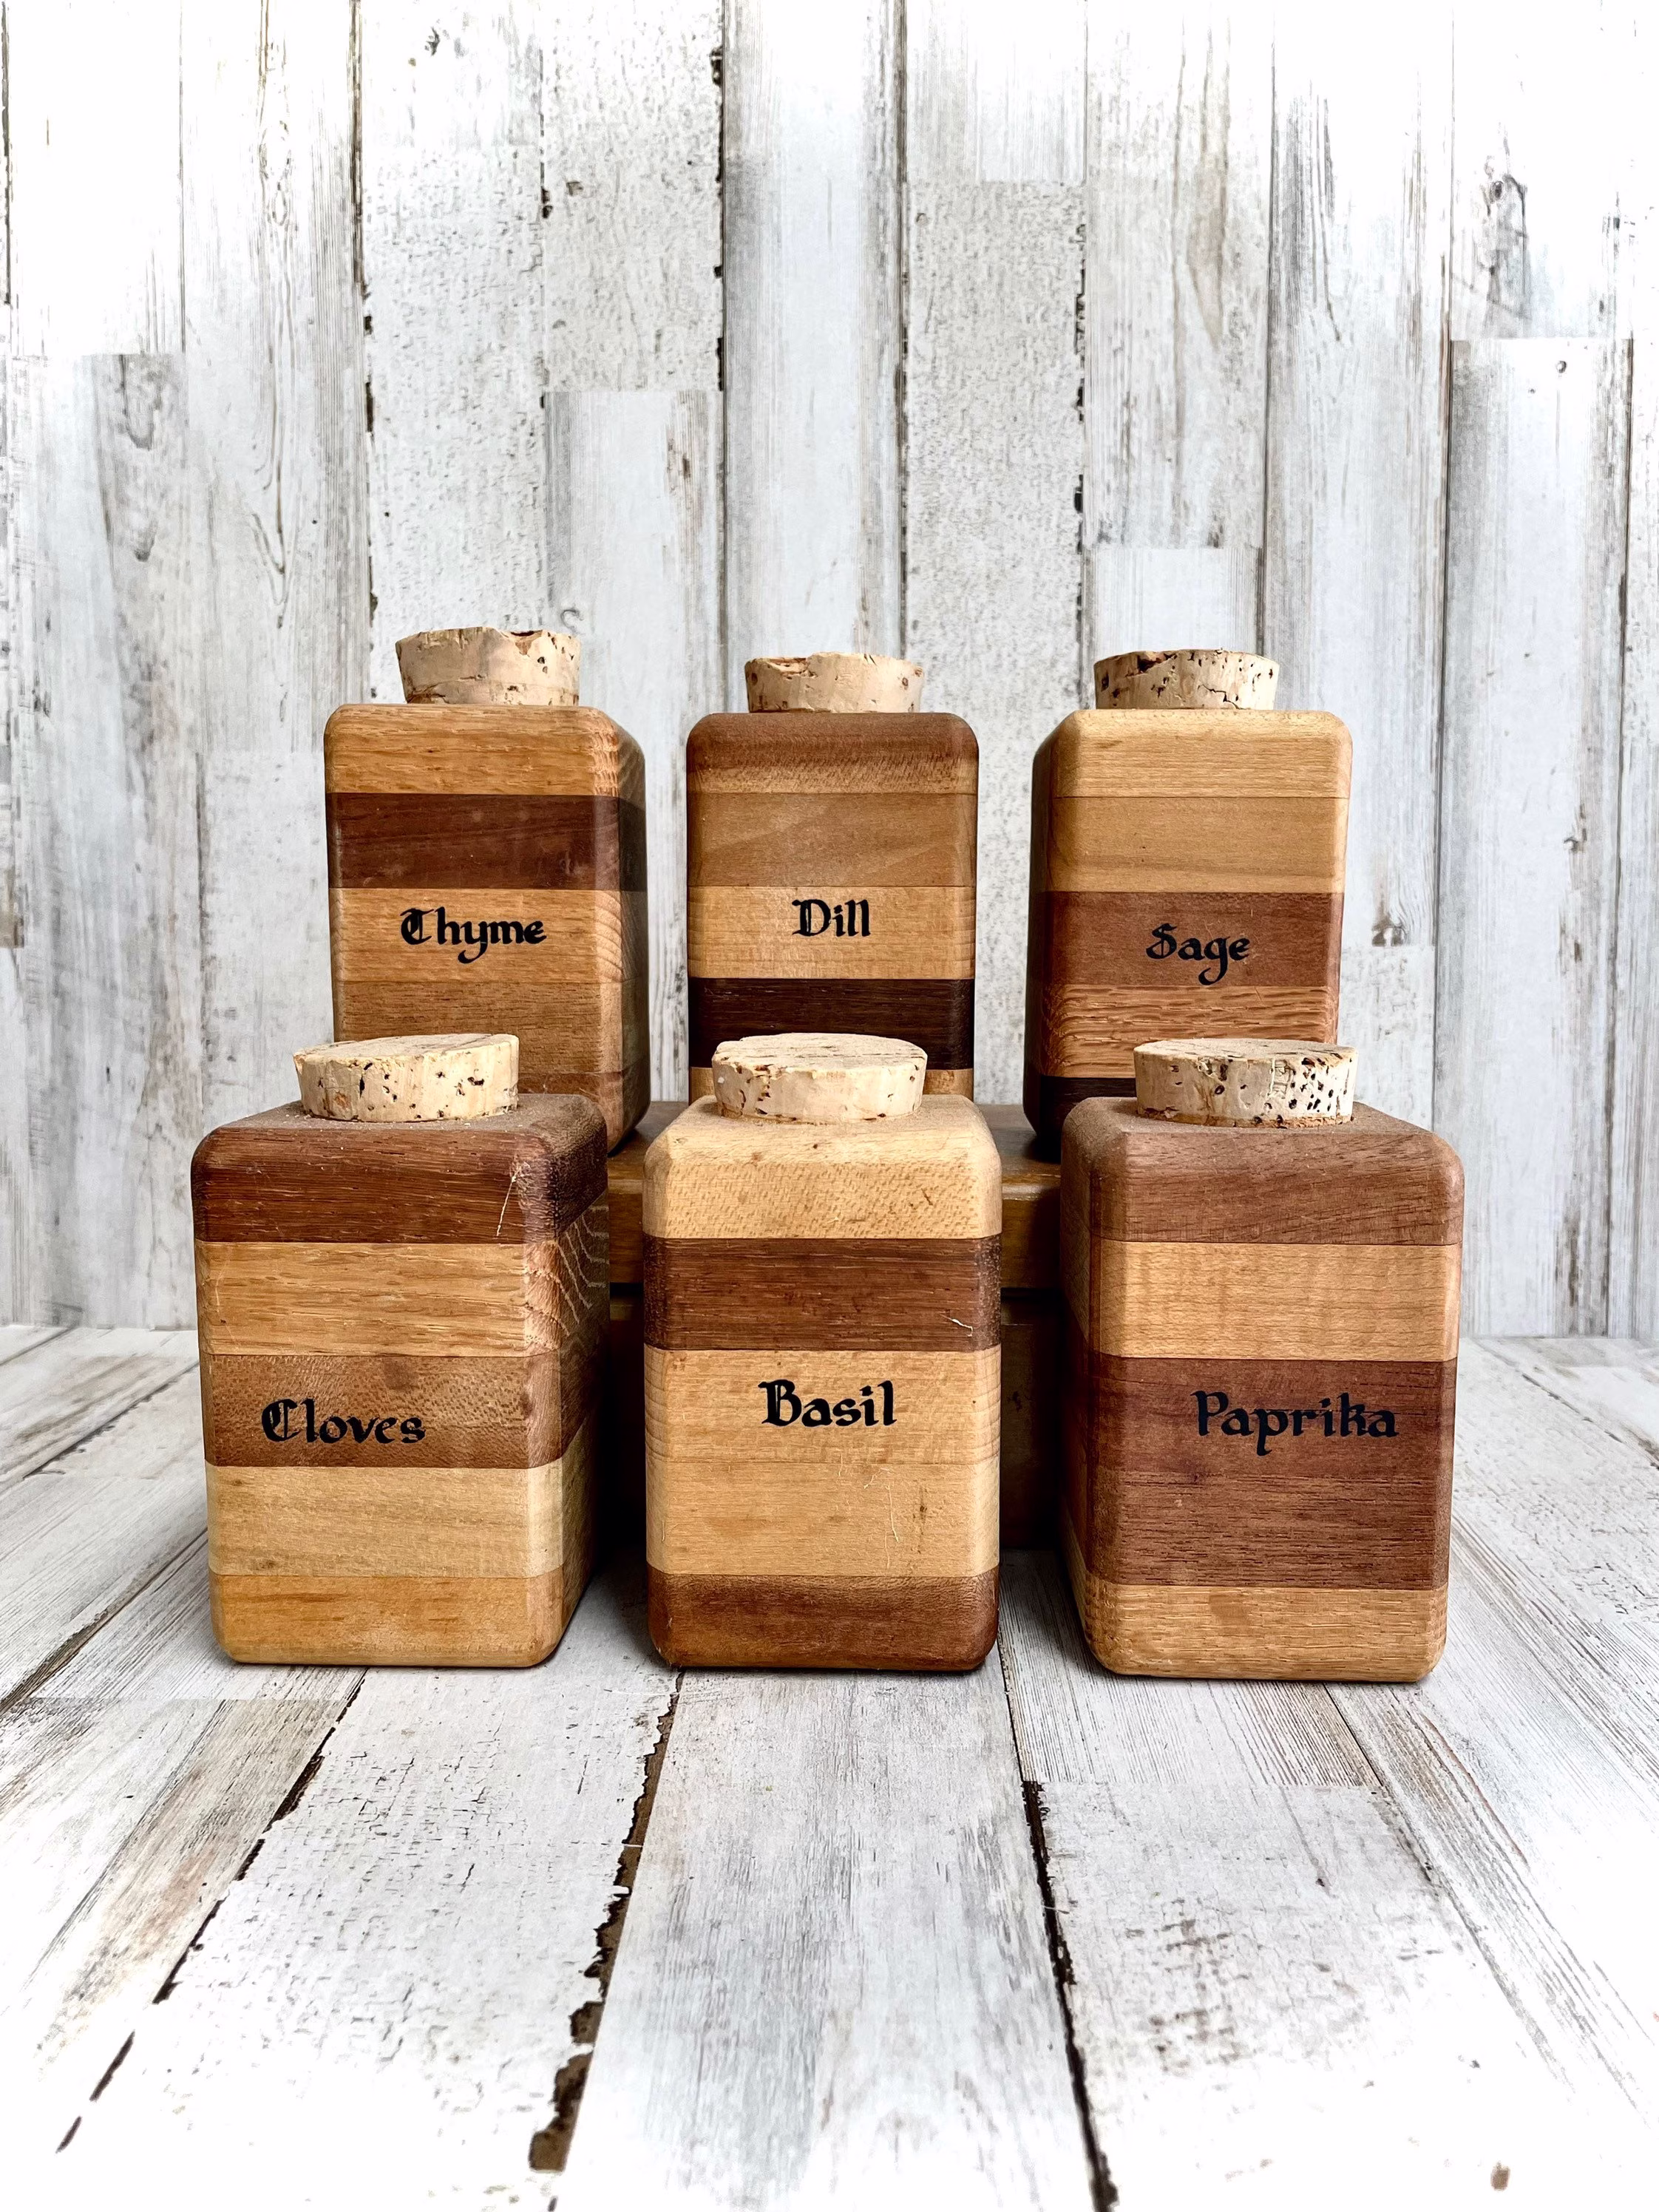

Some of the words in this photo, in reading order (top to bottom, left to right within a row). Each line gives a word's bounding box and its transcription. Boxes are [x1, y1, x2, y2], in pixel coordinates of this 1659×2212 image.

[401, 906, 546, 964] Thyme
[792, 899, 871, 937] Dill
[1145, 923, 1251, 986] Sage
[262, 1397, 427, 1445] Cloves
[758, 1379, 898, 1428] Basil
[1190, 1390, 1398, 1456] Paprika
